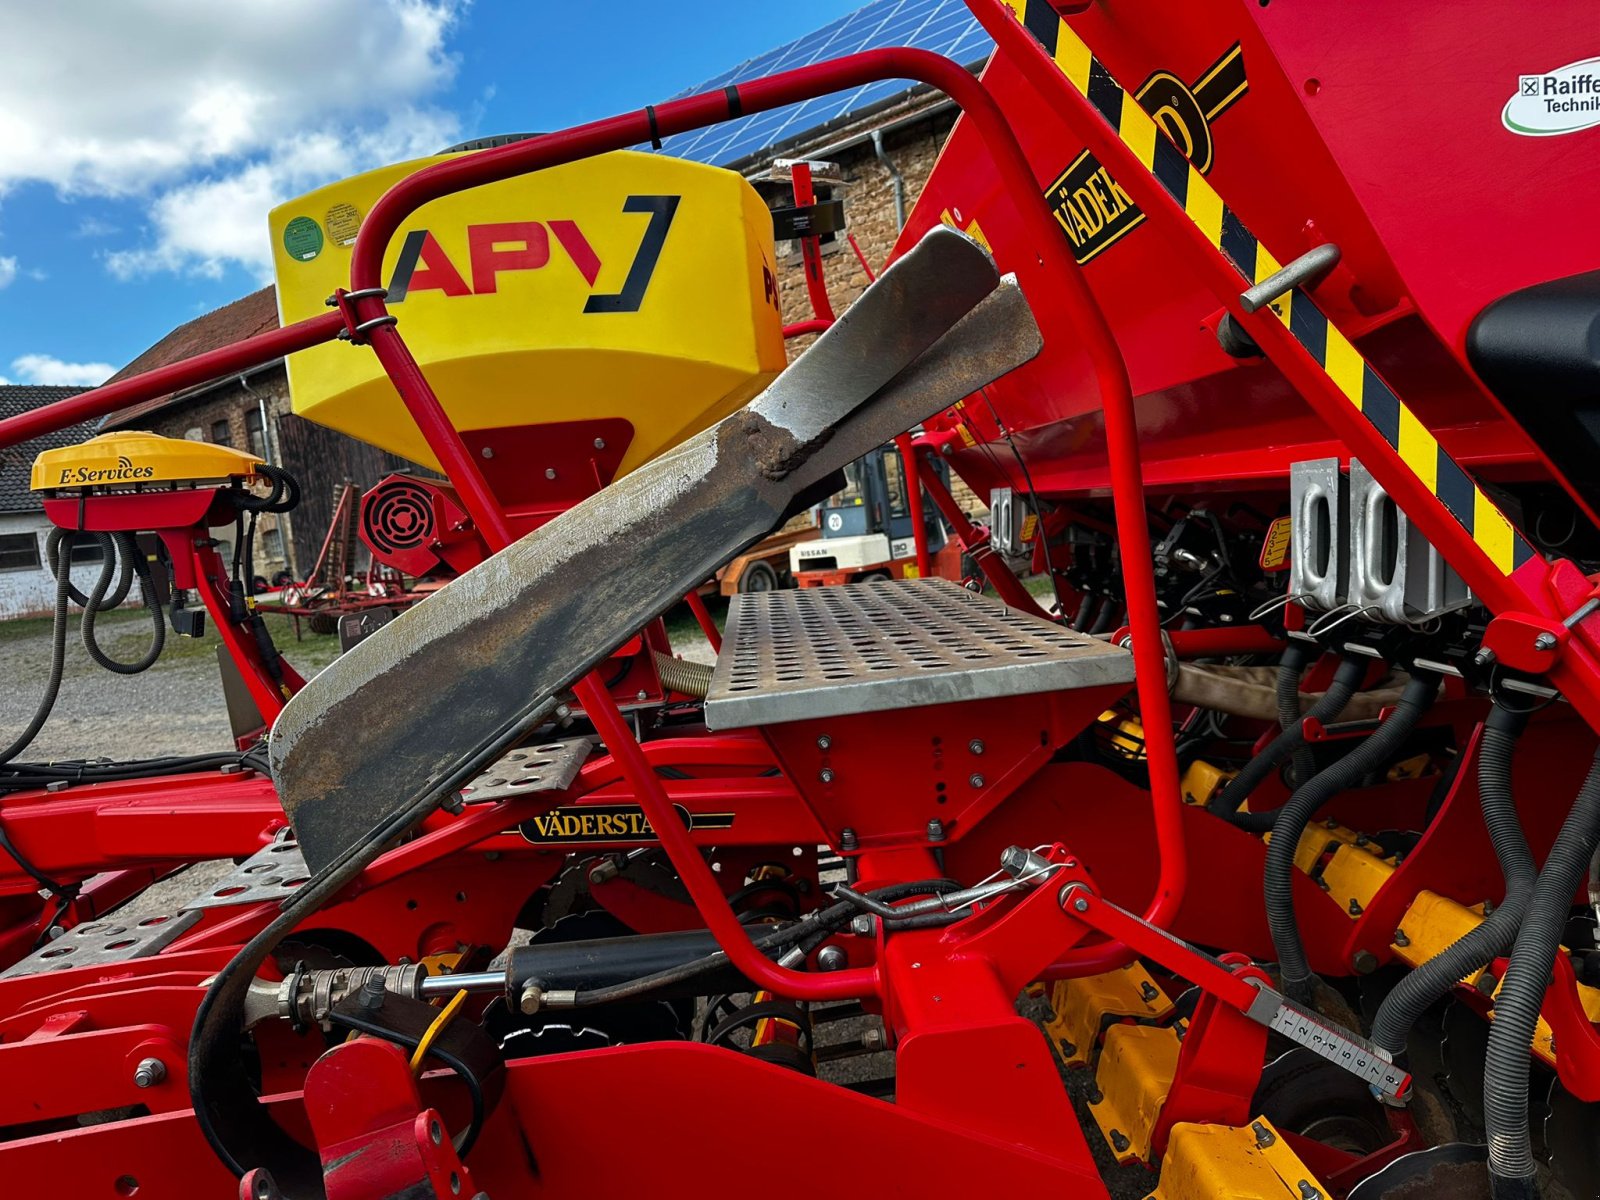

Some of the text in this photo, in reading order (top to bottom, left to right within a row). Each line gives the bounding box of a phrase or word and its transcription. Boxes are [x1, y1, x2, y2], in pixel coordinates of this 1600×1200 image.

[59, 464, 154, 485] E-Services
[831, 516, 840, 528] 20
[1271, 530, 1278, 540] 2
[1269, 539, 1275, 549] 3
[1267, 548, 1273, 556] 4
[1264, 557, 1271, 566] 5
[534, 810, 658, 837] VÄDERSTA
[1284, 1019, 1293, 1027] 1
[1298, 1026, 1309, 1036] 2
[1312, 1034, 1323, 1044] 3
[1328, 1042, 1338, 1051] 4
[1342, 1050, 1352, 1060] 5
[1356, 1058, 1367, 1068] 6
[1370, 1066, 1380, 1076] 7
[1385, 1074, 1395, 1084] 8
